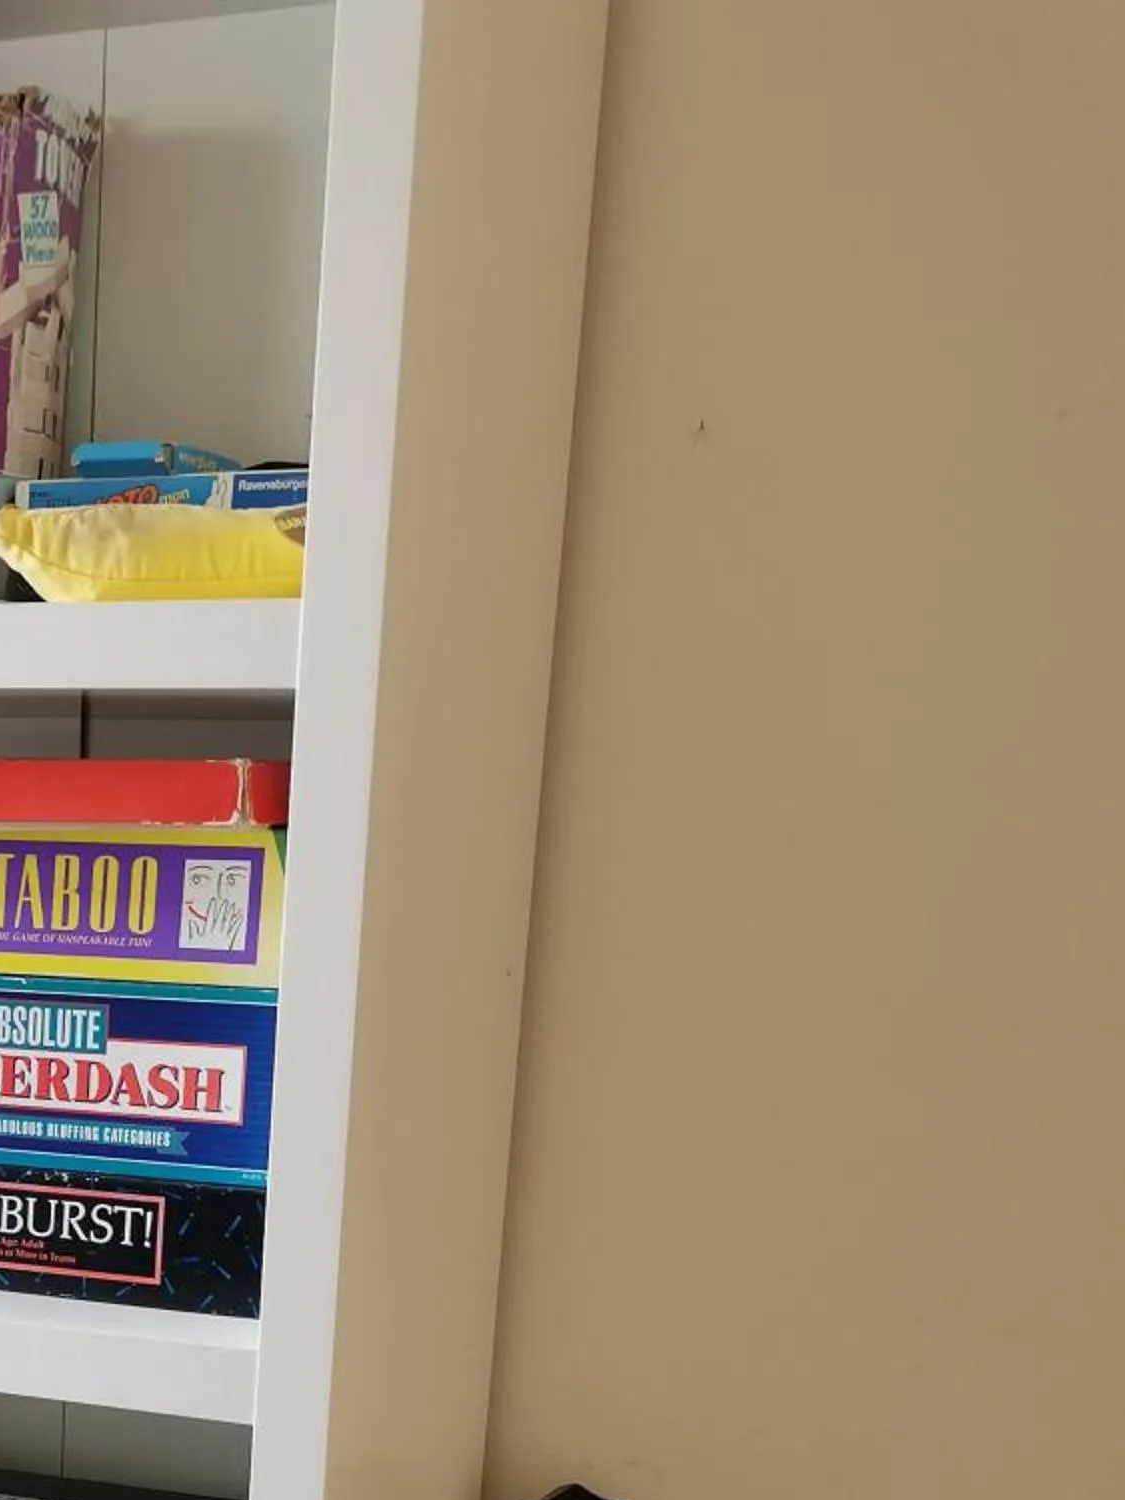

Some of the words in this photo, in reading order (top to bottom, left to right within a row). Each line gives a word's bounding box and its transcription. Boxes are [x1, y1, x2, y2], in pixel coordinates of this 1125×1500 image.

[30, 196, 50, 219] 57
[237, 478, 308, 492] Ravensburge
[46, 1121, 99, 1142] BLUFFING
[103, 1126, 172, 1149] CATEGORIES
